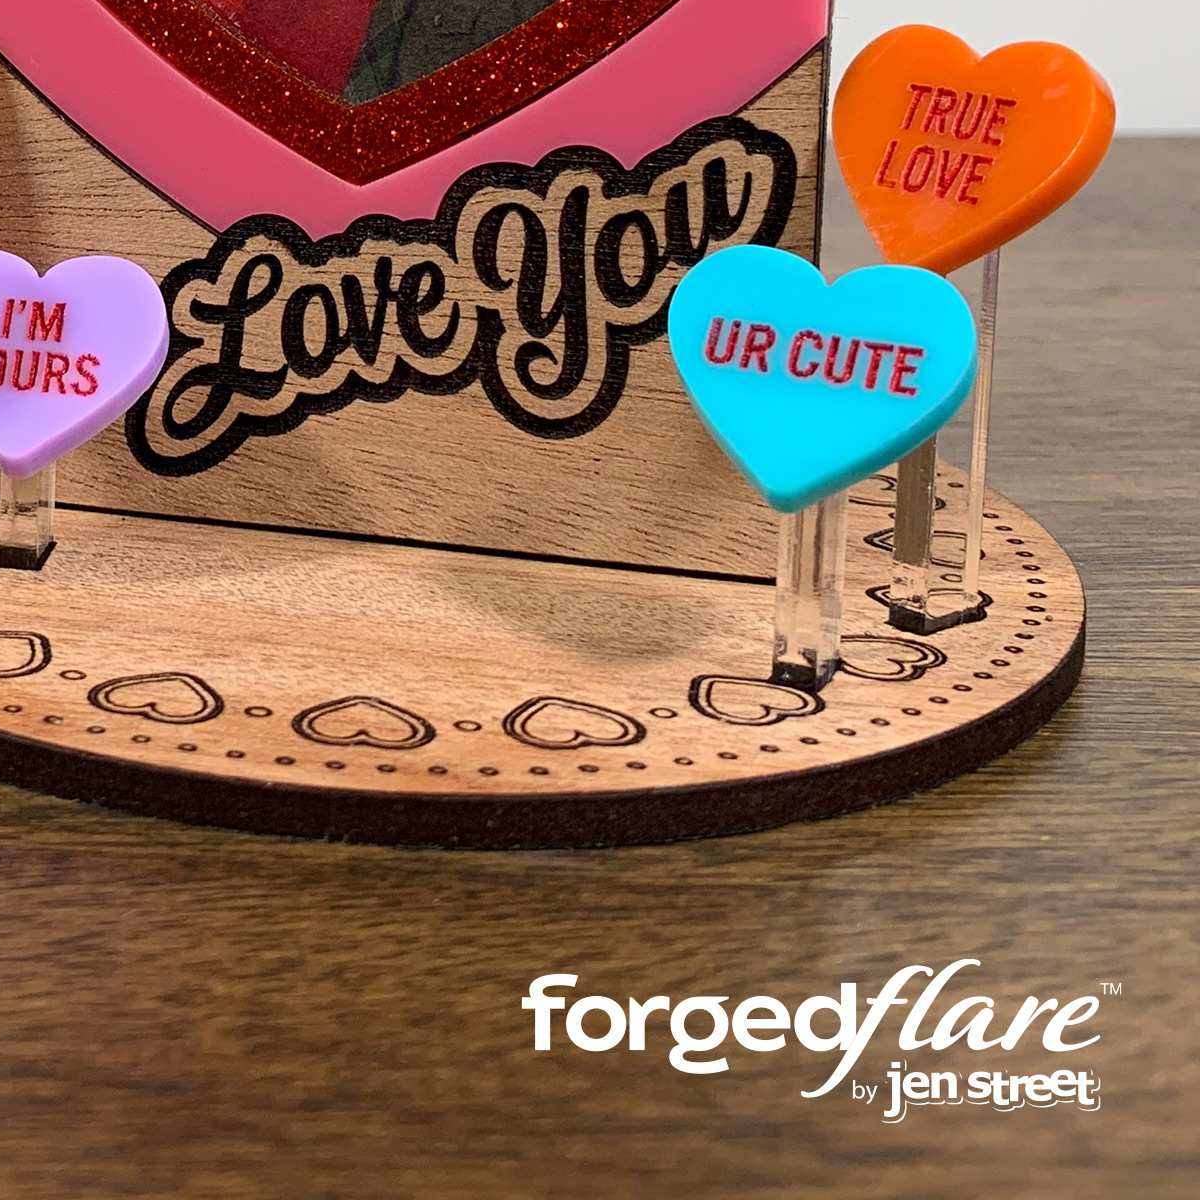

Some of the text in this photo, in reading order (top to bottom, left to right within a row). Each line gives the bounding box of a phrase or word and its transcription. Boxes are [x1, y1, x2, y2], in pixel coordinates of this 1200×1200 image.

[900, 83, 1017, 146] TRUE
[873, 140, 994, 205] LOVE
[0, 298, 66, 343] I'M
[162, 157, 753, 440] Love You
[704, 317, 924, 396] UR CUTE
